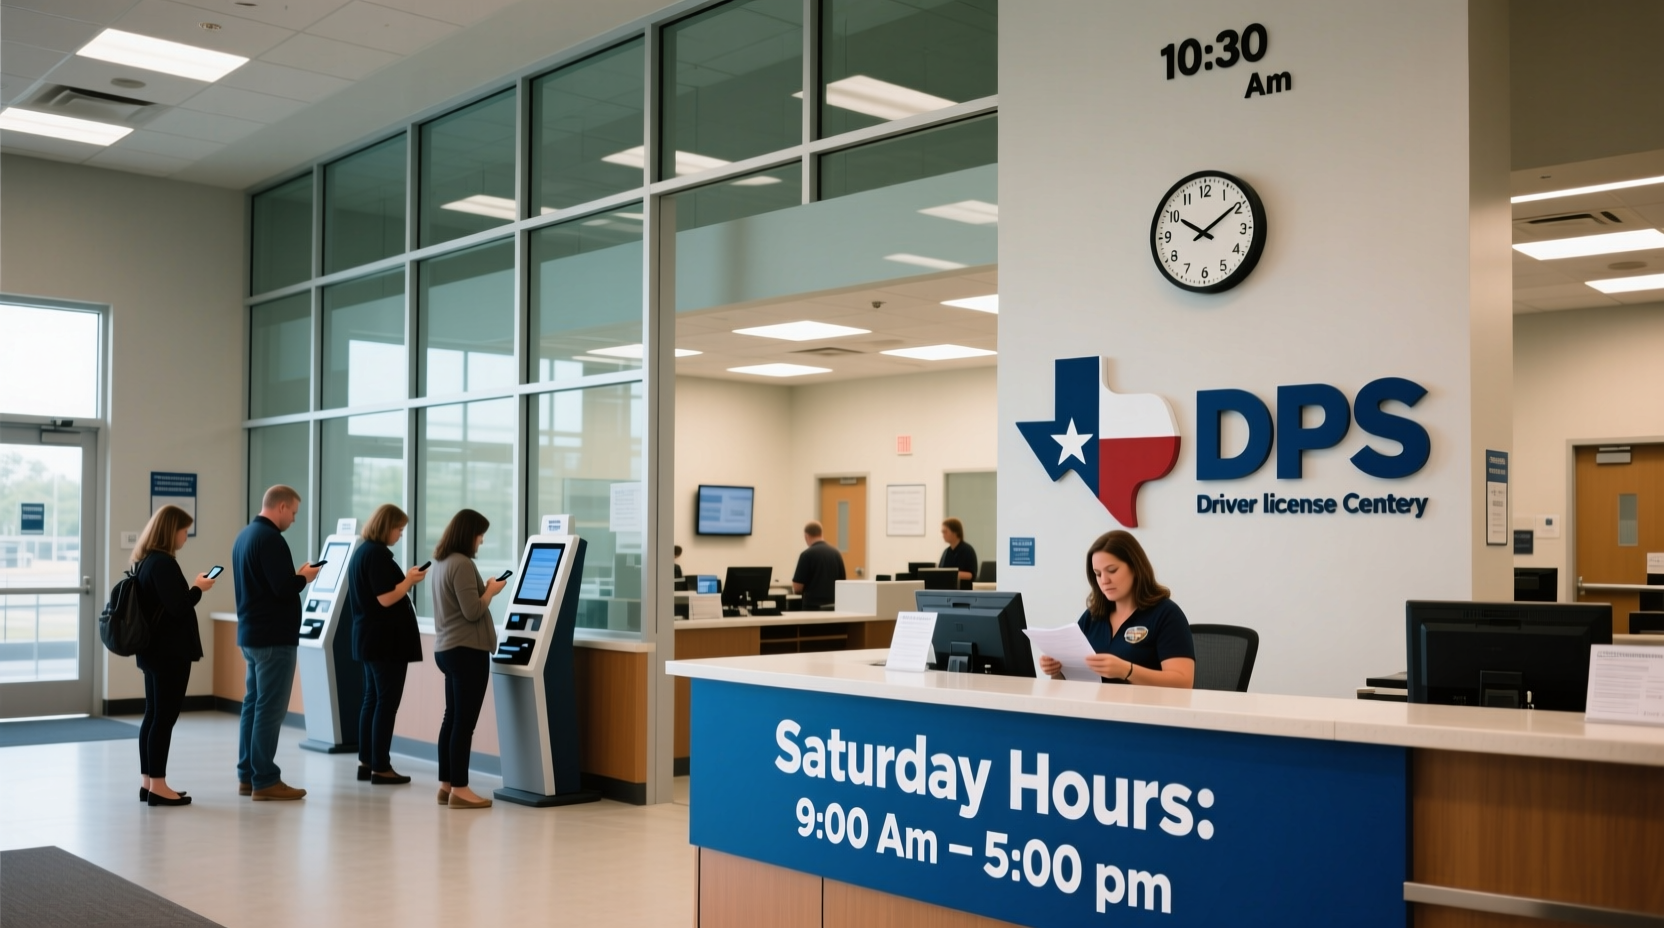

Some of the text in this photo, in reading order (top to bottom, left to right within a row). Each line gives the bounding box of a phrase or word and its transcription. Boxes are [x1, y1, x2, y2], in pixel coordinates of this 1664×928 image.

[1161, 23, 1268, 80] 10:30
[1244, 71, 1292, 99] Am
[1199, 184, 1212, 199] 12
[1222, 189, 1226, 201] 1
[1183, 193, 1192, 206] 11
[1234, 201, 1243, 214] 2
[1169, 209, 1180, 223] 10
[1239, 222, 1247, 235] 3
[1164, 230, 1172, 243] 9
[1231, 242, 1241, 255] 4
[1170, 249, 1178, 262] 8
[1183, 262, 1191, 275] 7
[1219, 259, 1228, 272] 5
[1201, 266, 1209, 279] 6
[1196, 376, 1432, 481] DPS
[1197, 493, 1258, 514] Driver
[1263, 493, 1338, 514] license
[775, 719, 1215, 840] Saturday Hours:
[796, 797, 869, 849] 9:00
[876, 812, 938, 864] Am
[983, 830, 1083, 894] 5:00
[1096, 863, 1172, 914] pm
